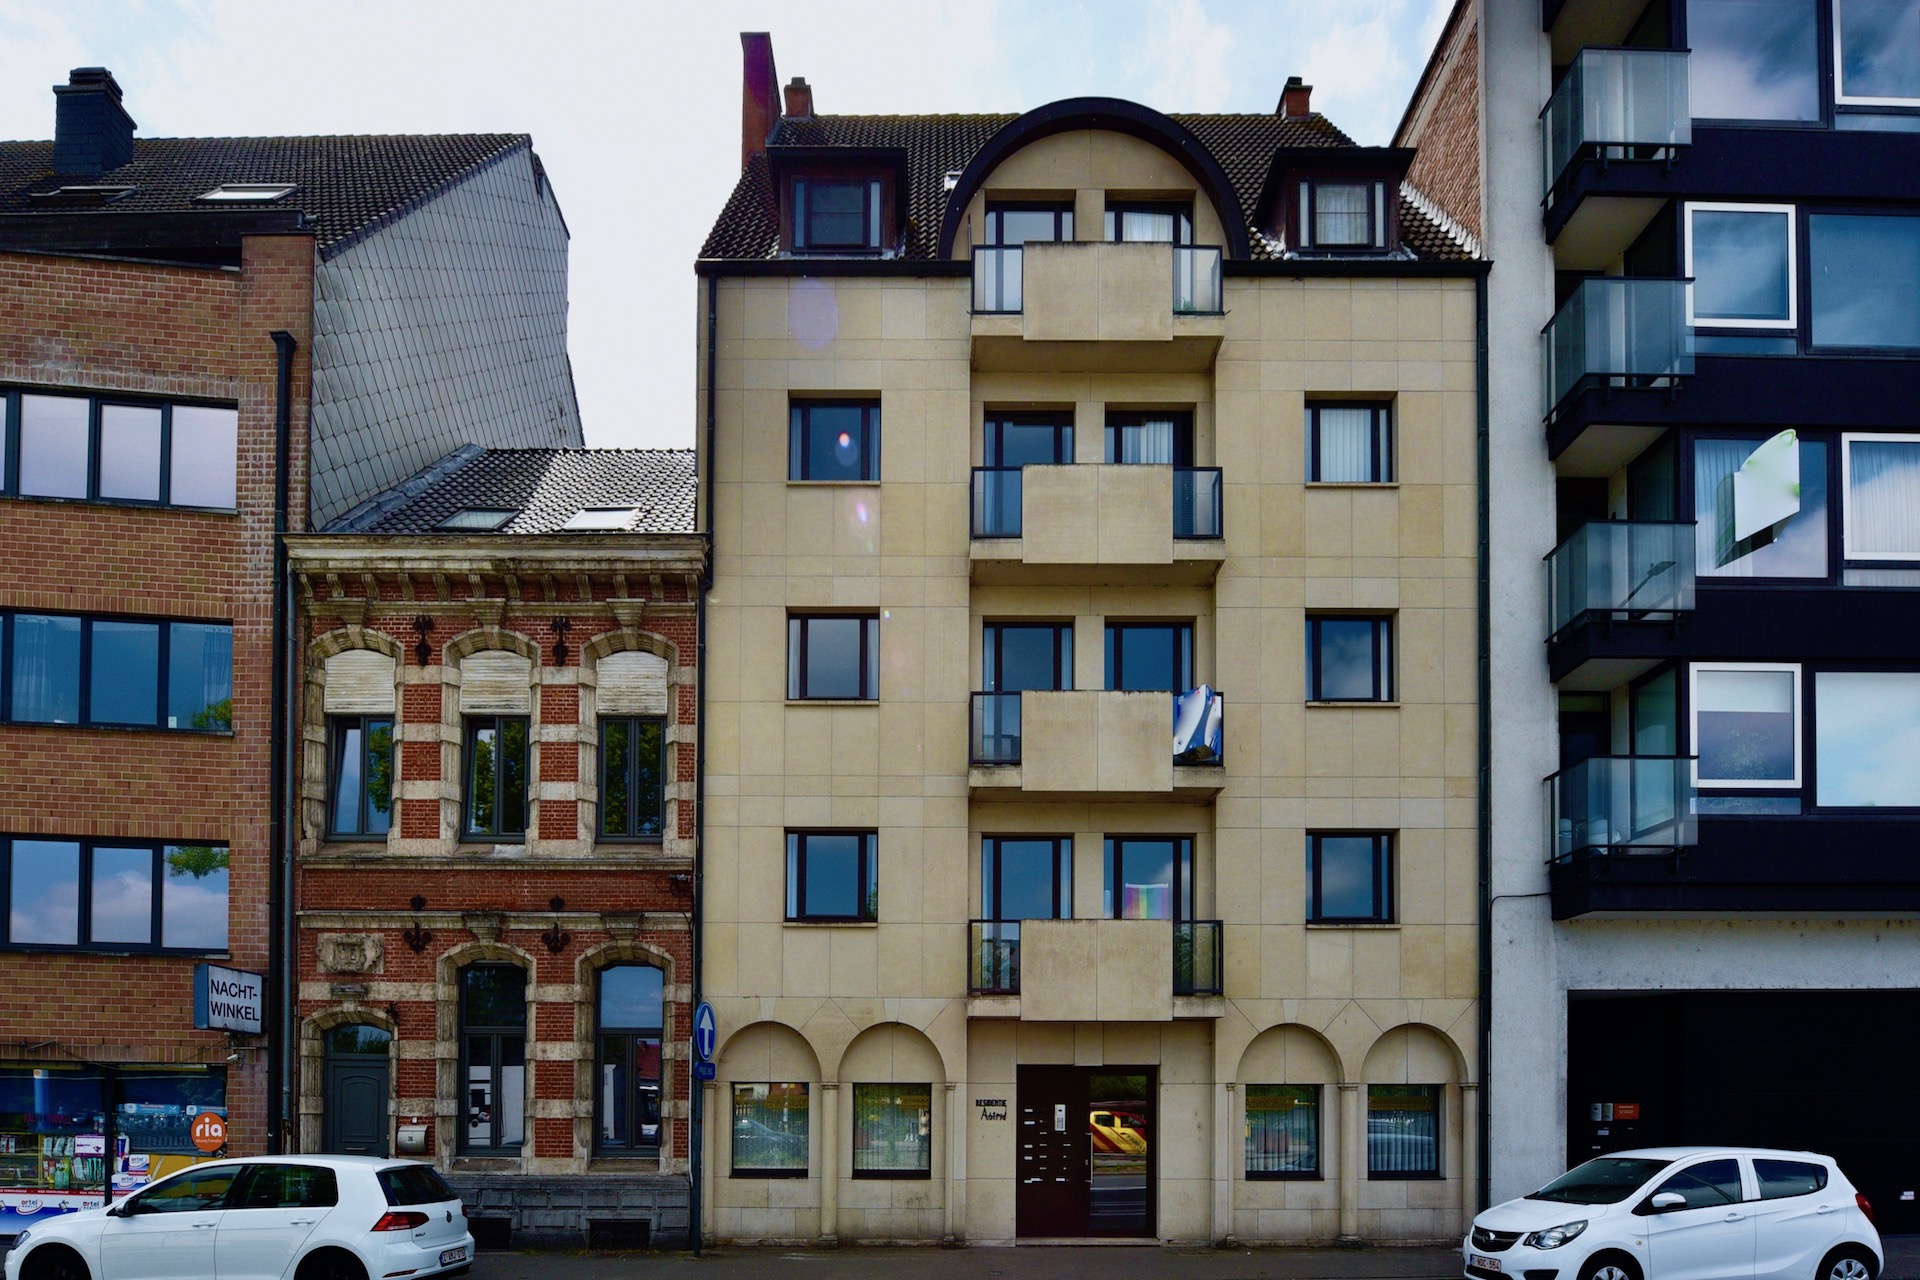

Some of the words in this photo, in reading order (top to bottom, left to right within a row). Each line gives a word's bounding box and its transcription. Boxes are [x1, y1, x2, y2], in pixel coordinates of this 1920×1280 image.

[210, 979, 258, 1000] NACHT-
[210, 1001, 260, 1021] WINKEL
[195, 1117, 223, 1137] ria
